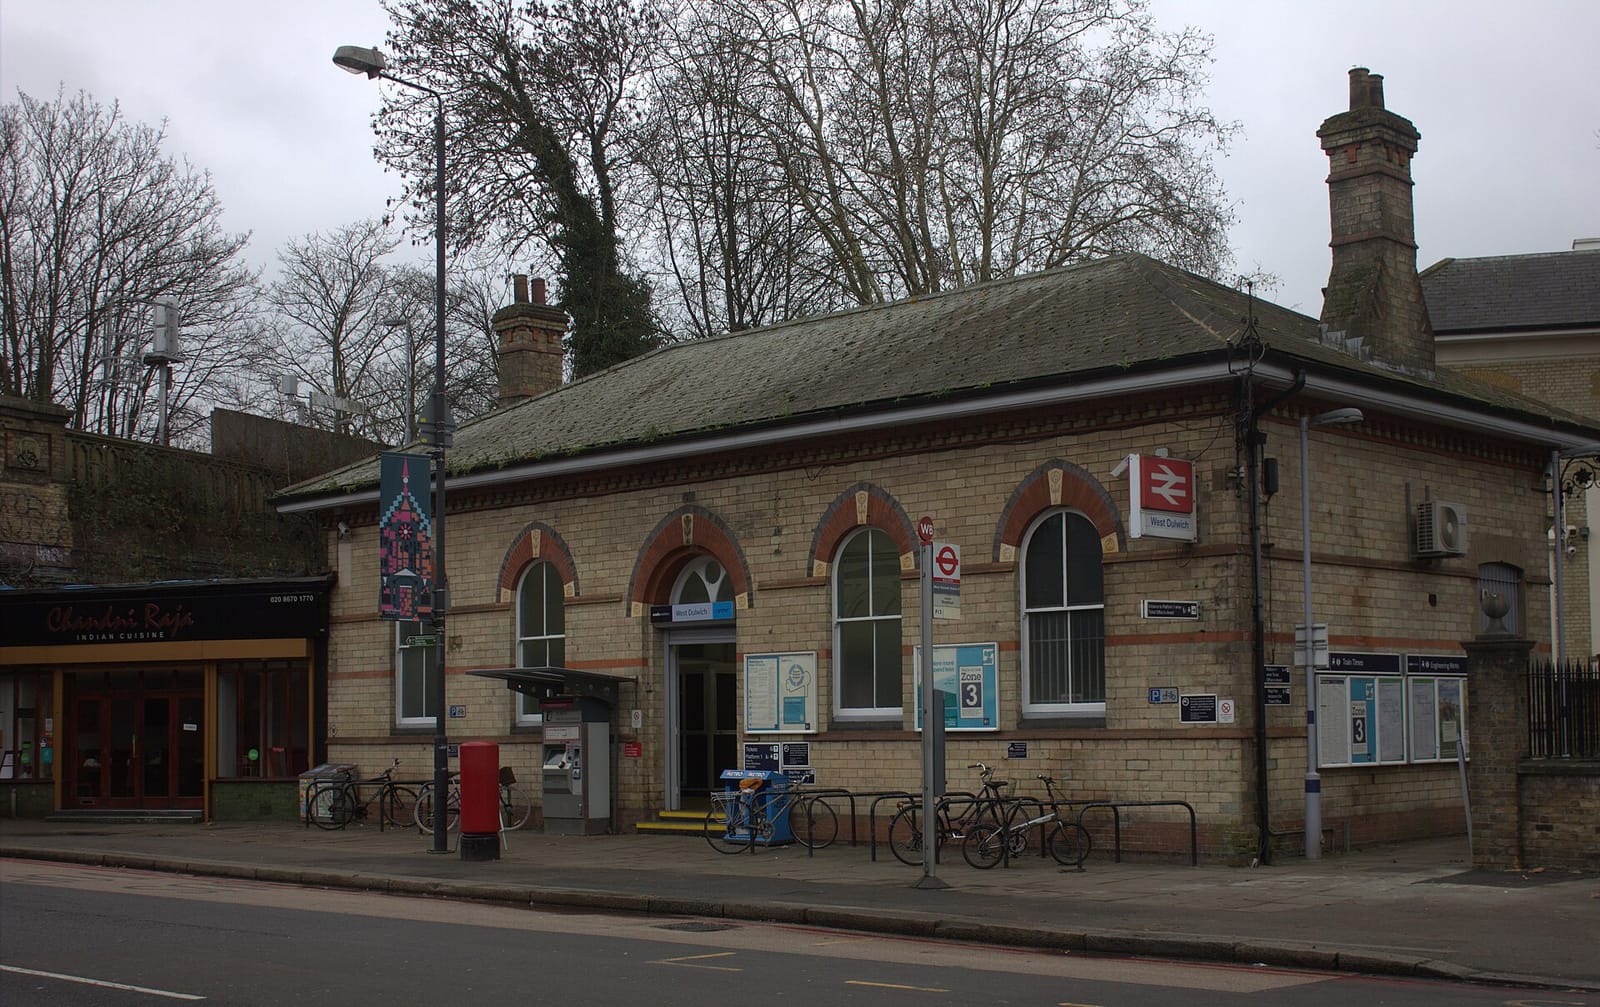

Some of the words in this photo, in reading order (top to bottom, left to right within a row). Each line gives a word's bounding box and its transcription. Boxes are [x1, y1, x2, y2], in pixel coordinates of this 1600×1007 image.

[1150, 516, 1165, 528] West
[1166, 518, 1189, 529] Dulwich
[676, 609, 688, 617] West
[688, 607, 708, 617] Dulwich
[47, 605, 138, 632] Chandni
[143, 601, 196, 638] Raja
[77, 633, 114, 641] INDIAN
[119, 631, 165, 640] CUISINE
[961, 672, 982, 681] Zone
[966, 684, 978, 706] 3
[1151, 690, 1159, 701] P
[1355, 719, 1364, 742] 3
